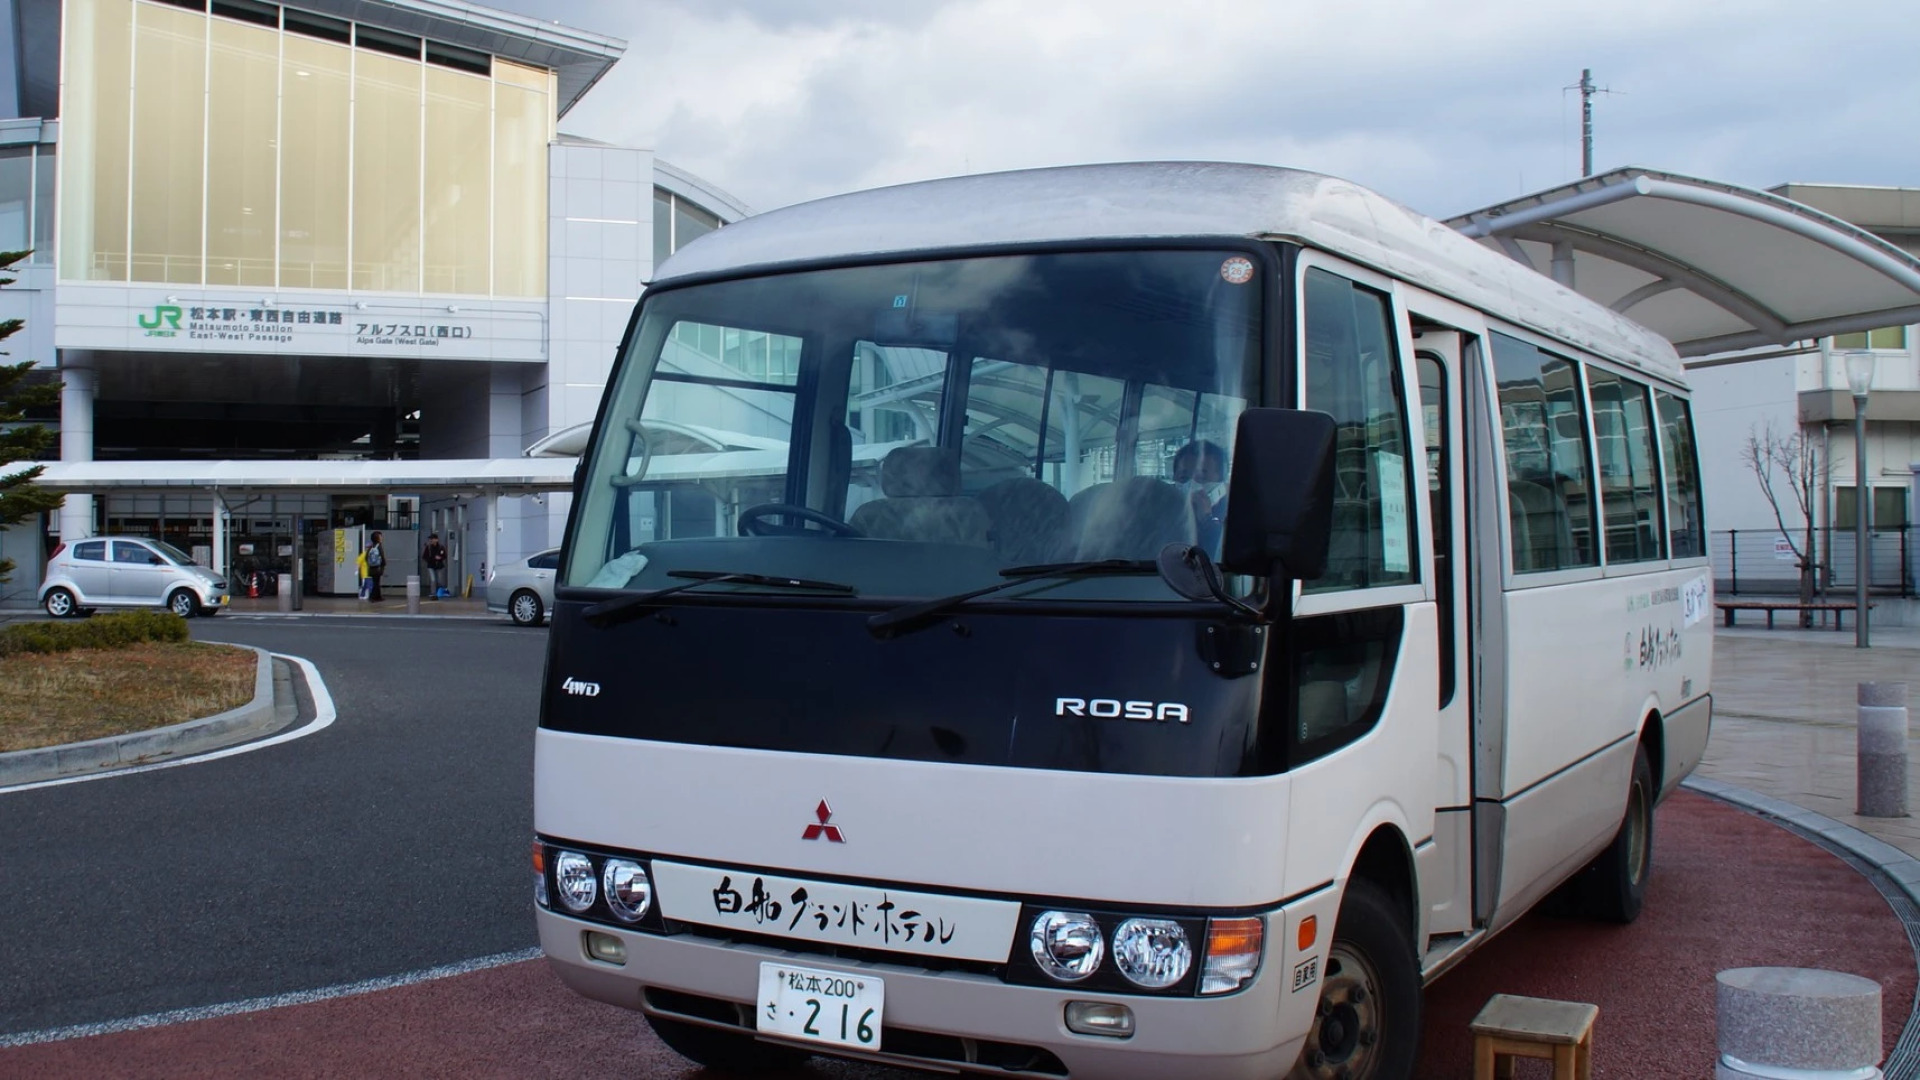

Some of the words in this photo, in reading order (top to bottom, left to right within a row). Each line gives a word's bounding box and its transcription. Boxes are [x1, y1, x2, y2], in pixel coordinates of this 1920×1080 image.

[139, 306, 182, 329] JR
[190, 307, 343, 325] 松本駅・東西自由通路
[190, 322, 249, 332] Matsumoto
[254, 323, 293, 333] Station
[190, 331, 244, 340] East-West
[249, 333, 293, 342] Passage
[375, 337, 393, 345] Gate
[394, 337, 417, 346] (West
[419, 338, 440, 346] Gate)
[562, 676, 600, 697] 4WD
[1056, 698, 1189, 722] ROSA
[713, 876, 956, 945] 白船グランドホテル
